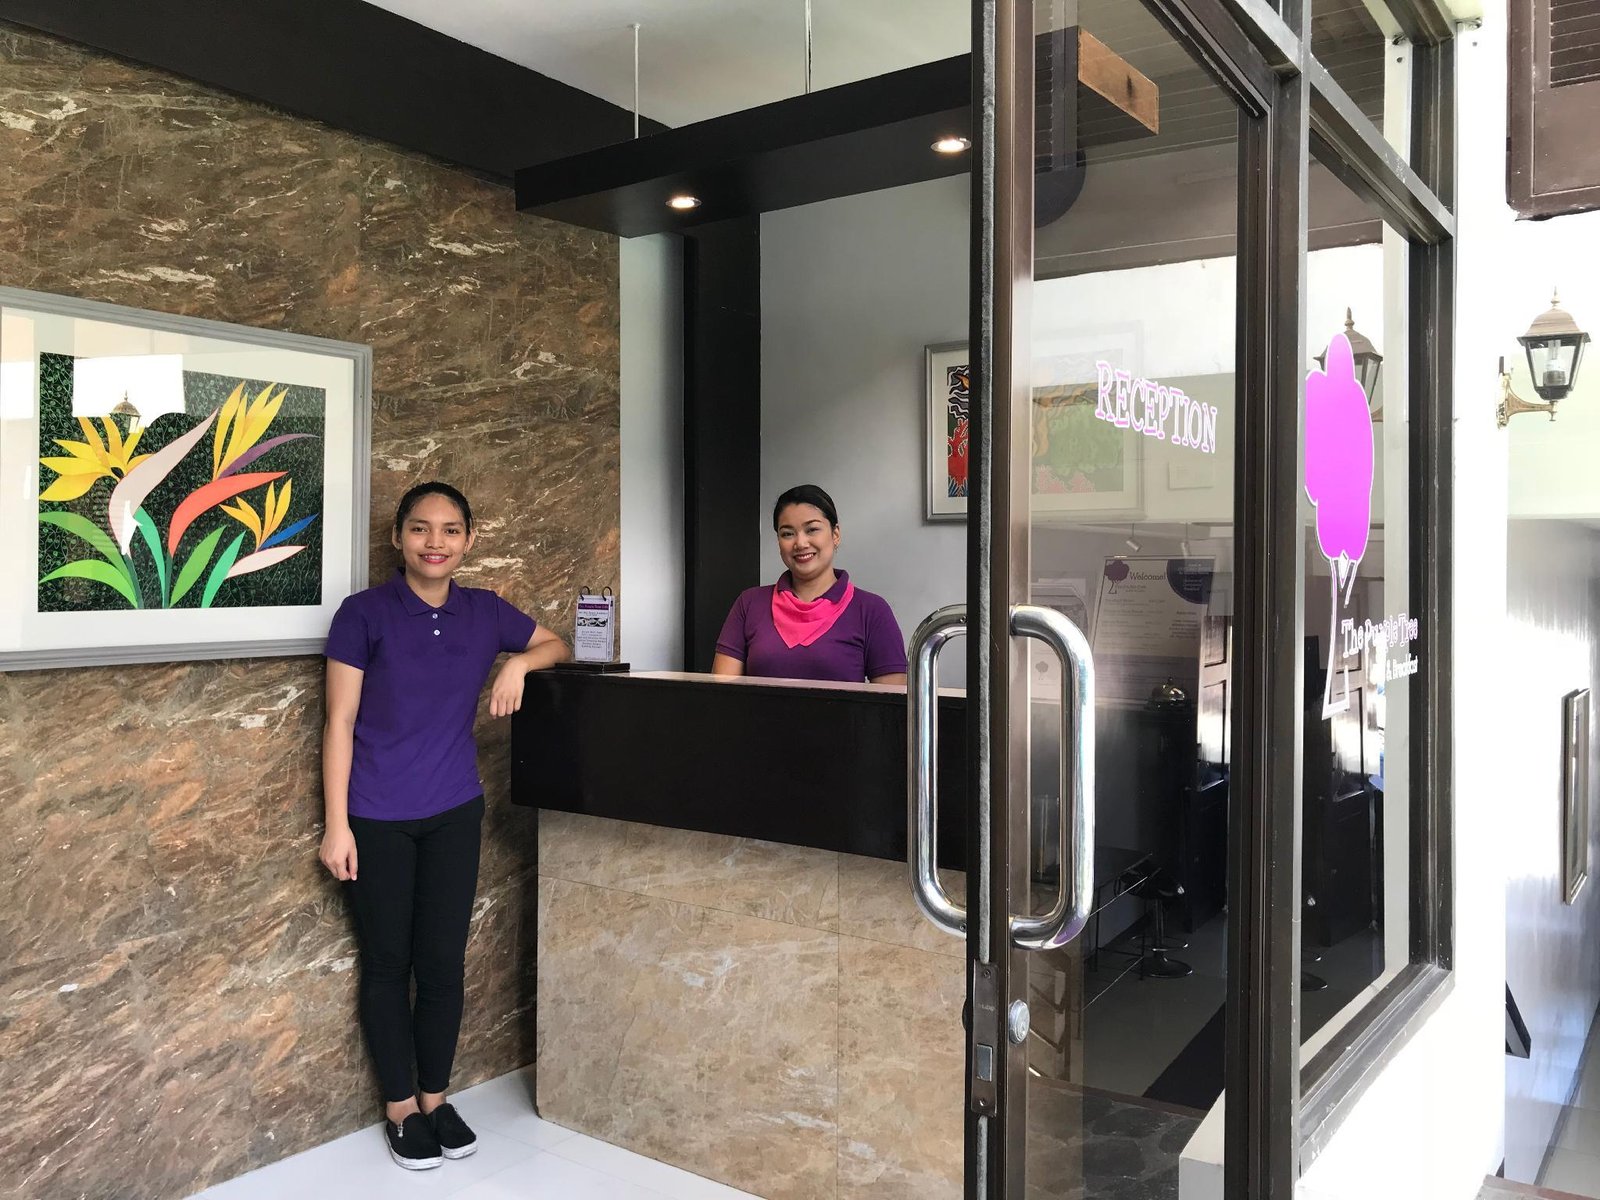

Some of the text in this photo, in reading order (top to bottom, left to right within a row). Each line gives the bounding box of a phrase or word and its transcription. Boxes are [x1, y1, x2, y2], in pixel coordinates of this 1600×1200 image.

[1095, 360, 1217, 454] RECEPTION
[1130, 571, 1166, 581] Welcome!
[1341, 618, 1364, 658] The
[1398, 613, 1418, 647] Tree
